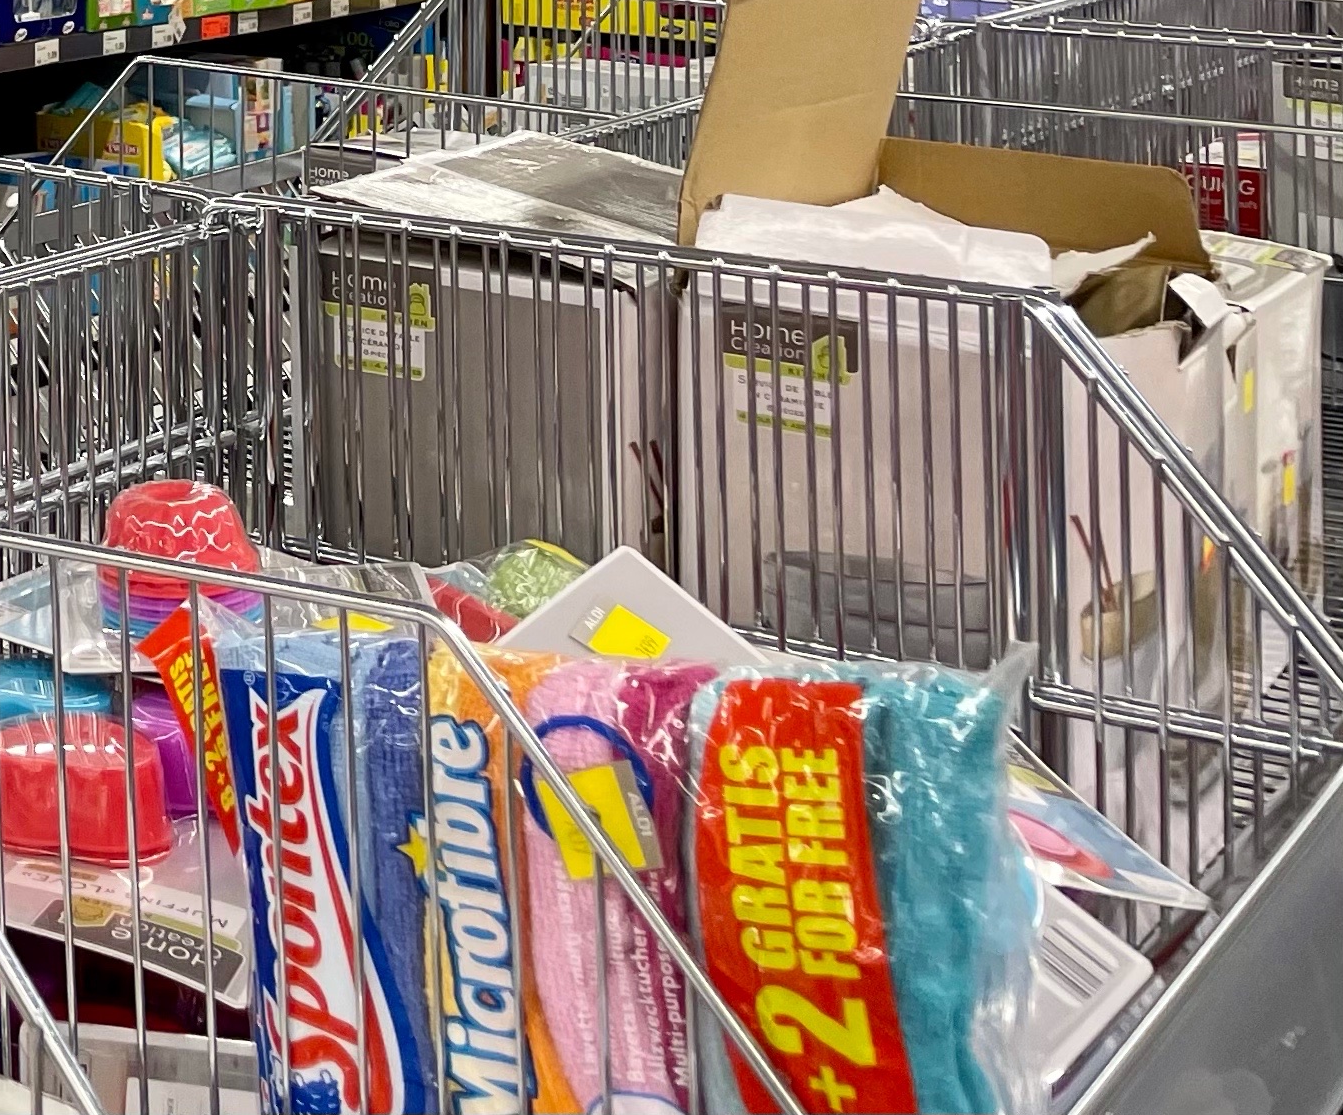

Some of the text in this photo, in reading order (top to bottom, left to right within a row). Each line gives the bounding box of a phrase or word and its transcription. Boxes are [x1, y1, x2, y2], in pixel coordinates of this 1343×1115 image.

[731, 337, 805, 360] Creaion
[584, 605, 606, 630] ALDI
[626, 791, 655, 838] ALDI
[718, 744, 798, 972] GRATIS
[780, 748, 848, 869] FREE
[246, 697, 361, 1115] Spontex
[430, 716, 533, 1115] Microfibre
